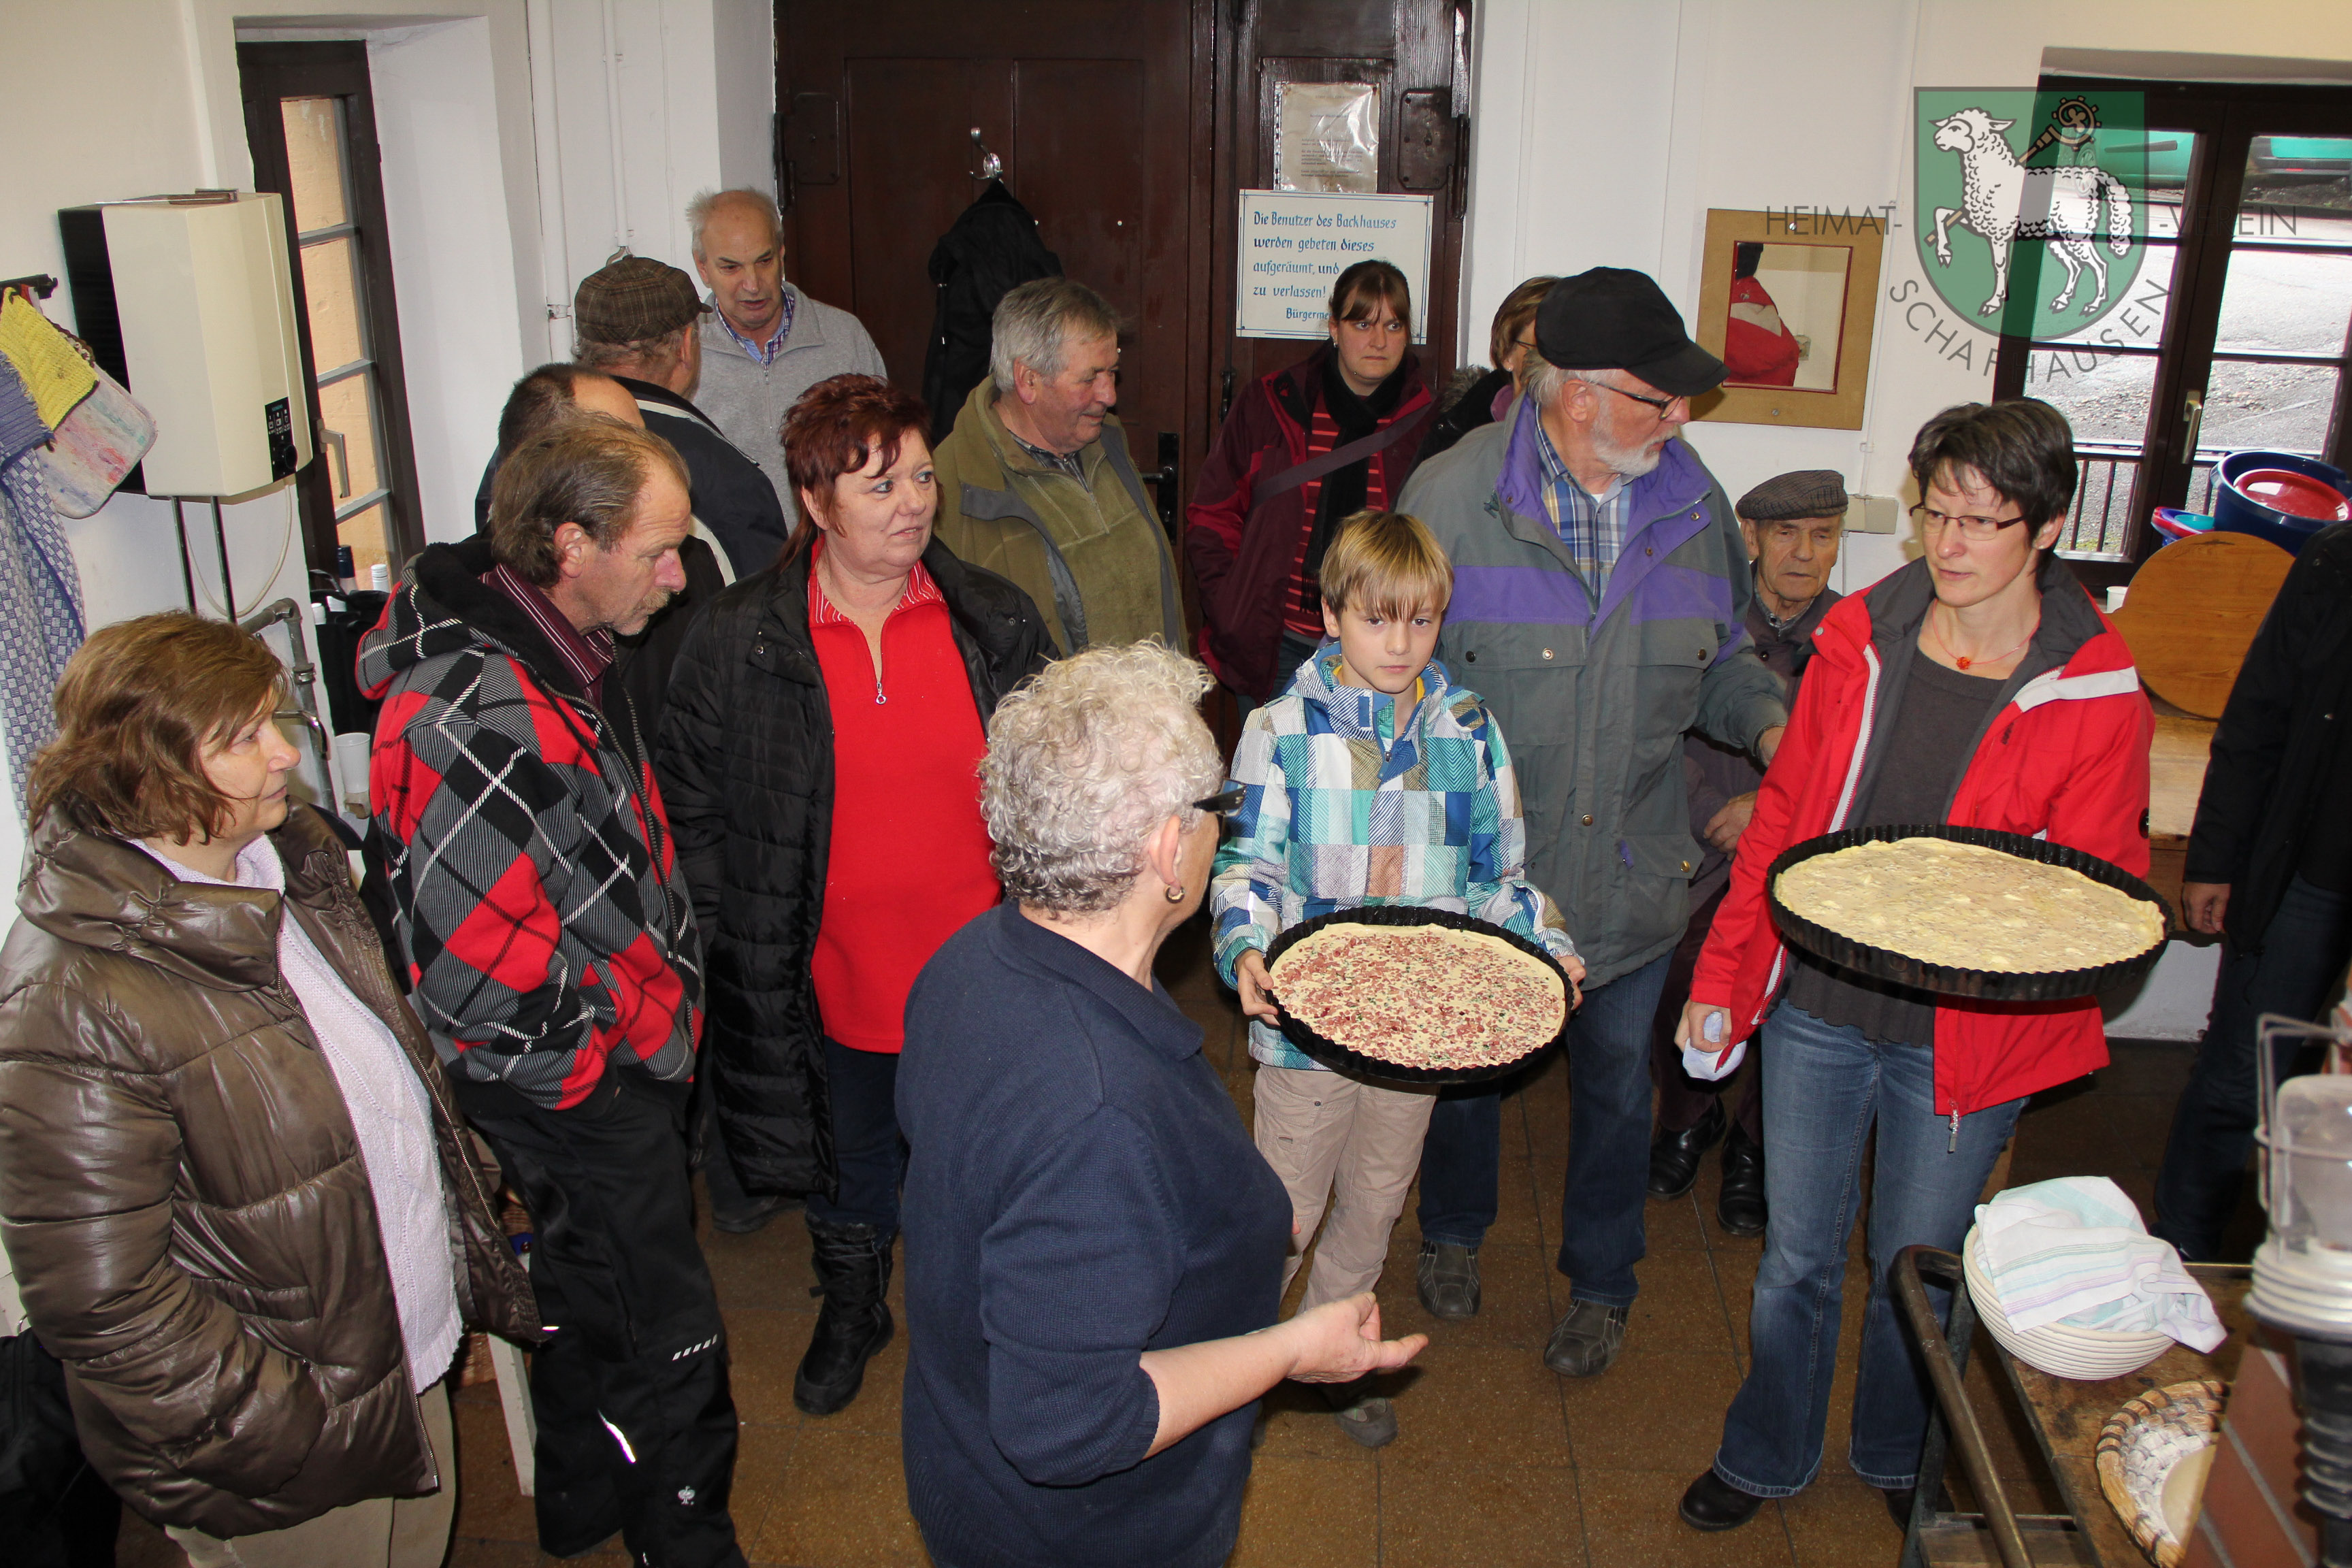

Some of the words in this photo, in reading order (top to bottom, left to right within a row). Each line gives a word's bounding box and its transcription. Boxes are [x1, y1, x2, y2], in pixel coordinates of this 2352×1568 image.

[1254, 211, 1269, 225] Die
[1271, 212, 1313, 226] Benutzer
[1316, 213, 1333, 227] des
[1337, 213, 1397, 229] Backhauses
[1254, 236, 1292, 248] werden
[1341, 238, 1375, 252] dieses
[1253, 260, 1315, 276] aufgeräumt,
[1318, 262, 1339, 275] und
[1253, 286, 1266, 296] zu
[1273, 284, 1326, 298] verlassen!
